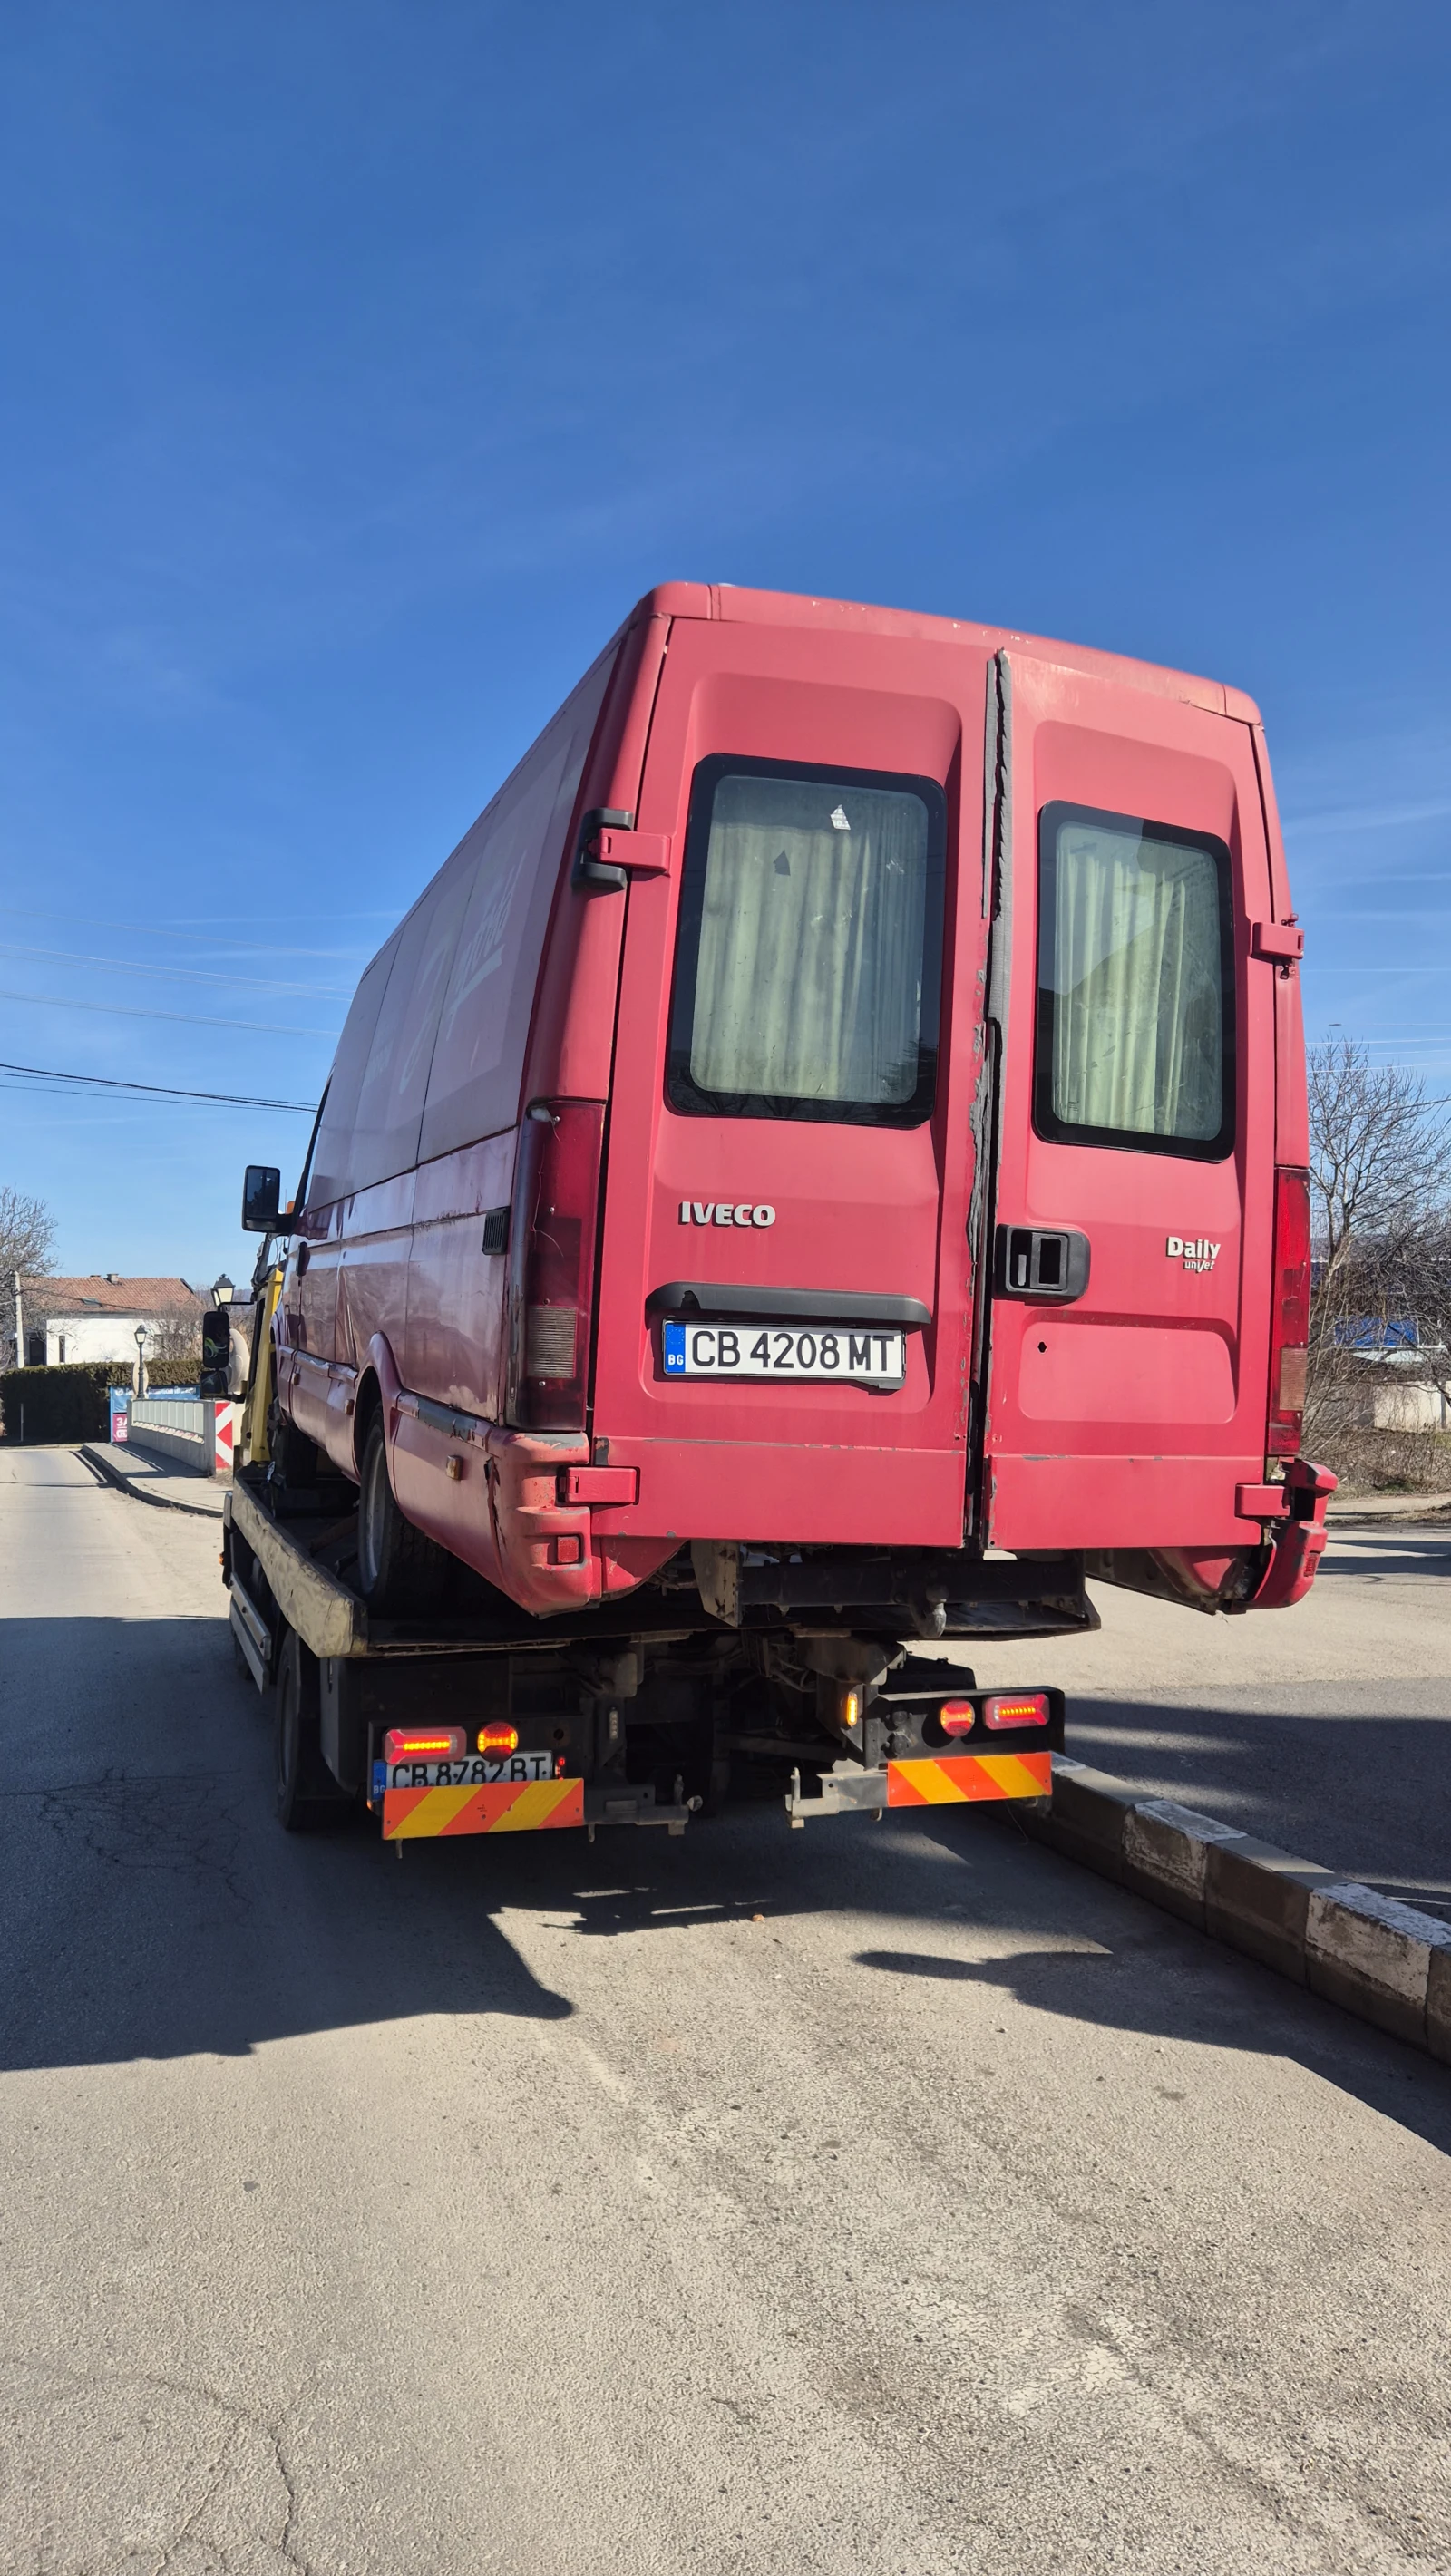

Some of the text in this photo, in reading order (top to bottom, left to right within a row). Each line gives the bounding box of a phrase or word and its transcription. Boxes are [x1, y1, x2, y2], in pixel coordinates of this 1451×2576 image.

[681, 1201, 776, 1227] IVECO
[1166, 1236, 1222, 1259] Daily
[667, 1354, 684, 1366] BG
[691, 1330, 895, 1372] CB 4208 MT
[510, 1756, 547, 1783] BT
[373, 1785, 385, 1794] BG
